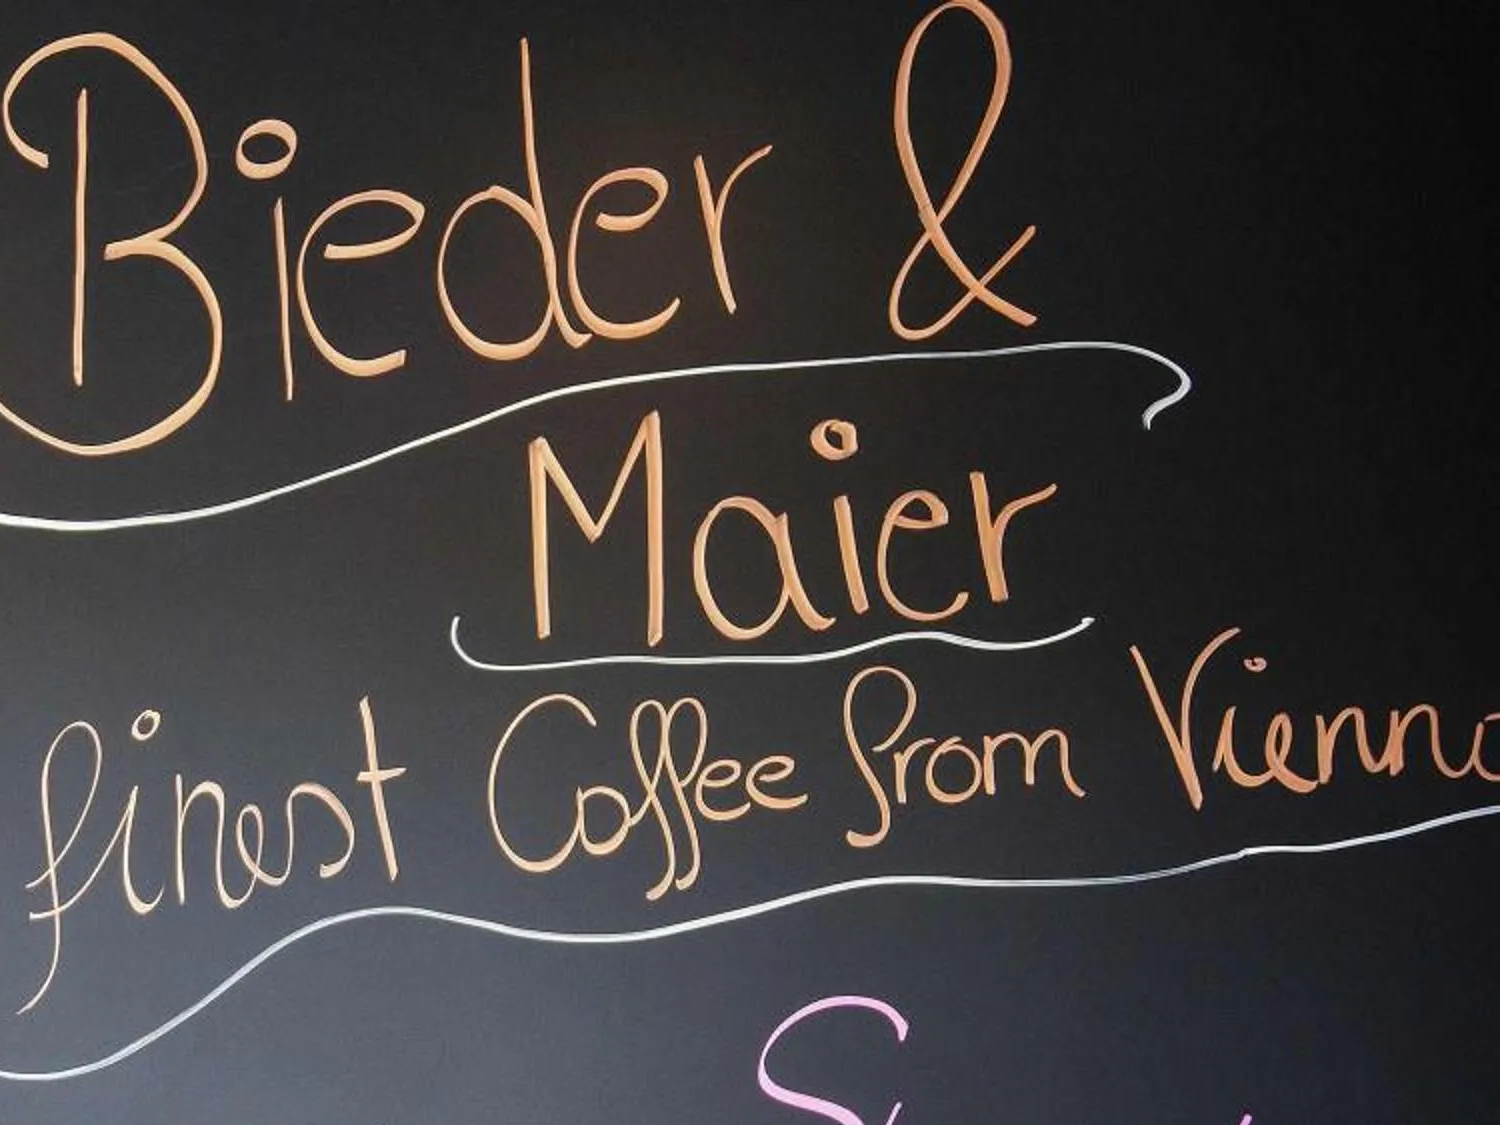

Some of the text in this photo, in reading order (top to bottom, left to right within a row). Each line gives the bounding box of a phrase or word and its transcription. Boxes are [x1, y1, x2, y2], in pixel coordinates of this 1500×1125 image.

[888, 0, 1038, 341] &
[528, 409, 1058, 648] Maier
[17, 695, 407, 1016] finest
[487, 693, 809, 902] Coffee
[843, 665, 1087, 848] from
